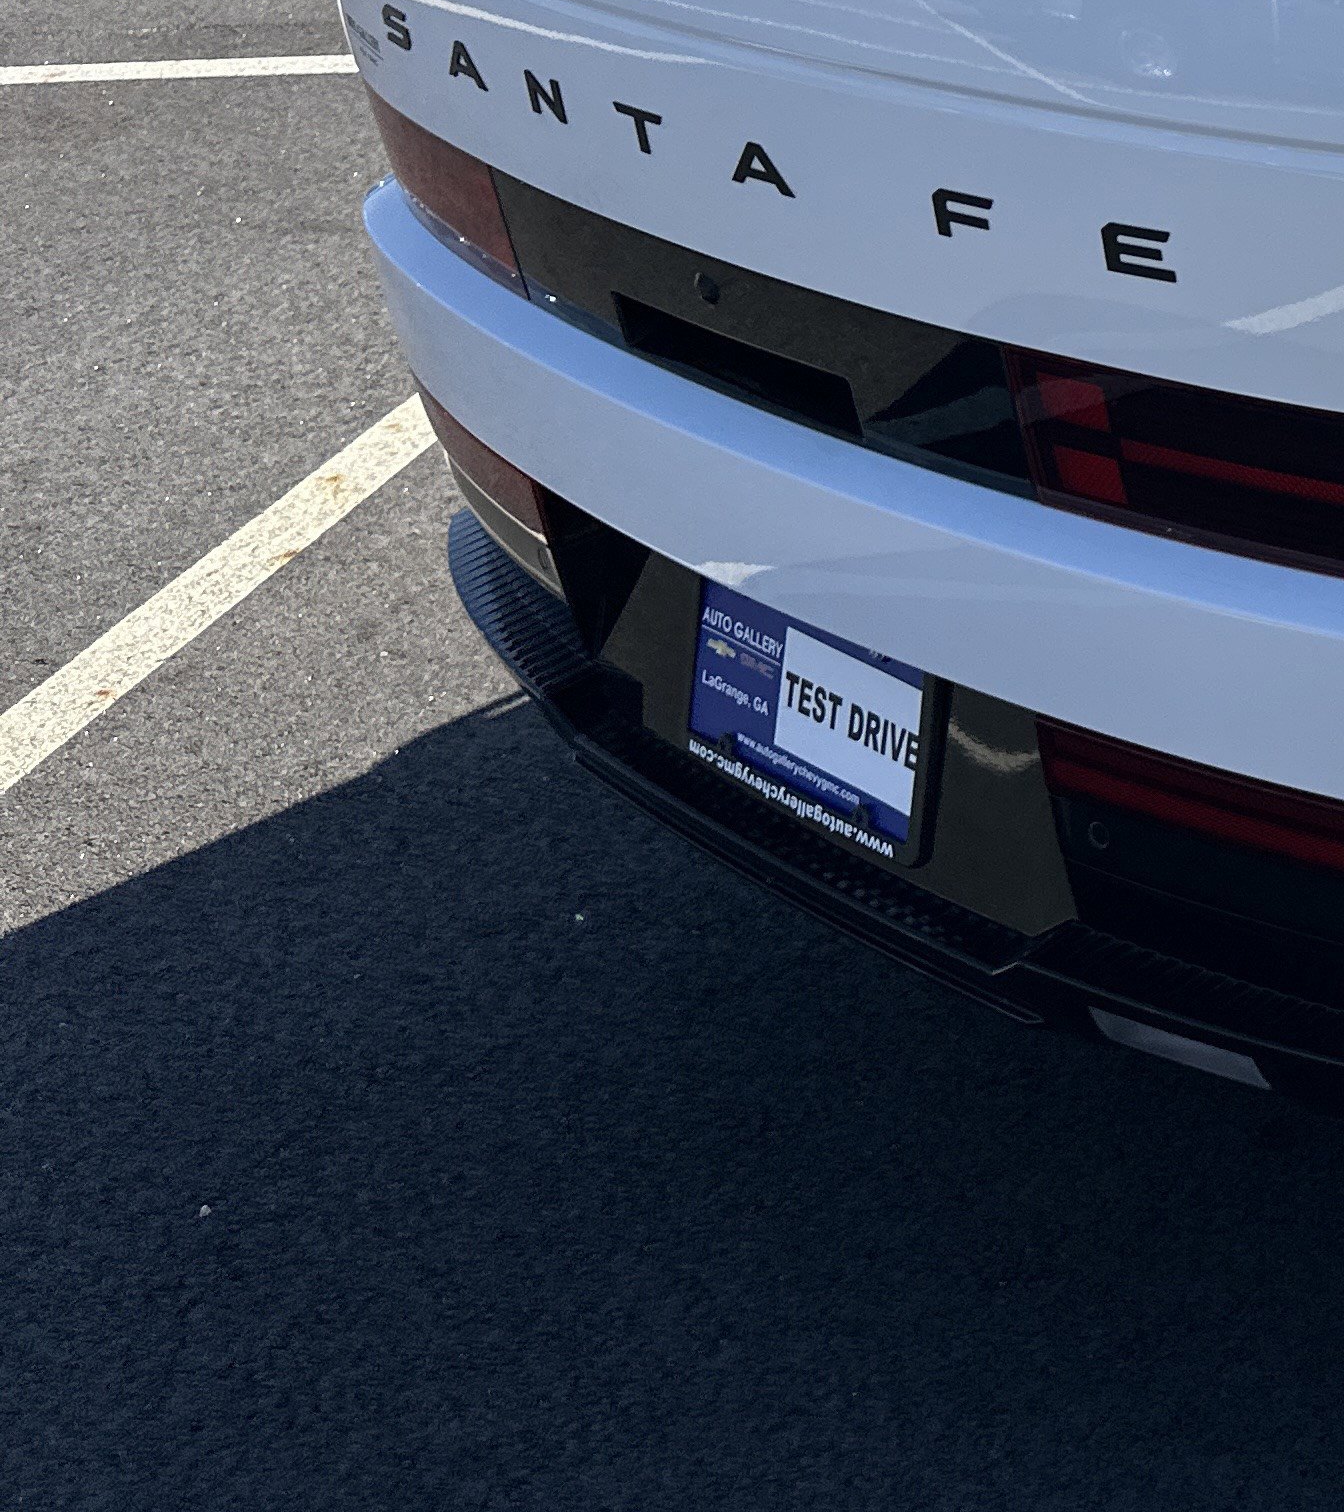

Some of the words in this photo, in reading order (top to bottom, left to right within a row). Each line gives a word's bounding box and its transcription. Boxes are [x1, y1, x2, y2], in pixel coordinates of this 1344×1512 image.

[382, 4, 796, 199] SANTA
[931, 188, 1177, 283] FE
[702, 606, 733, 633] AUTO
[734, 621, 783, 659] GALLERY
[702, 669, 752, 708] LaGrange,
[753, 696, 769, 717] GA
[785, 671, 842, 730] TEST
[847, 702, 920, 771] DRIVE
[689, 739, 895, 859] www.autogallerychevygmc.com
